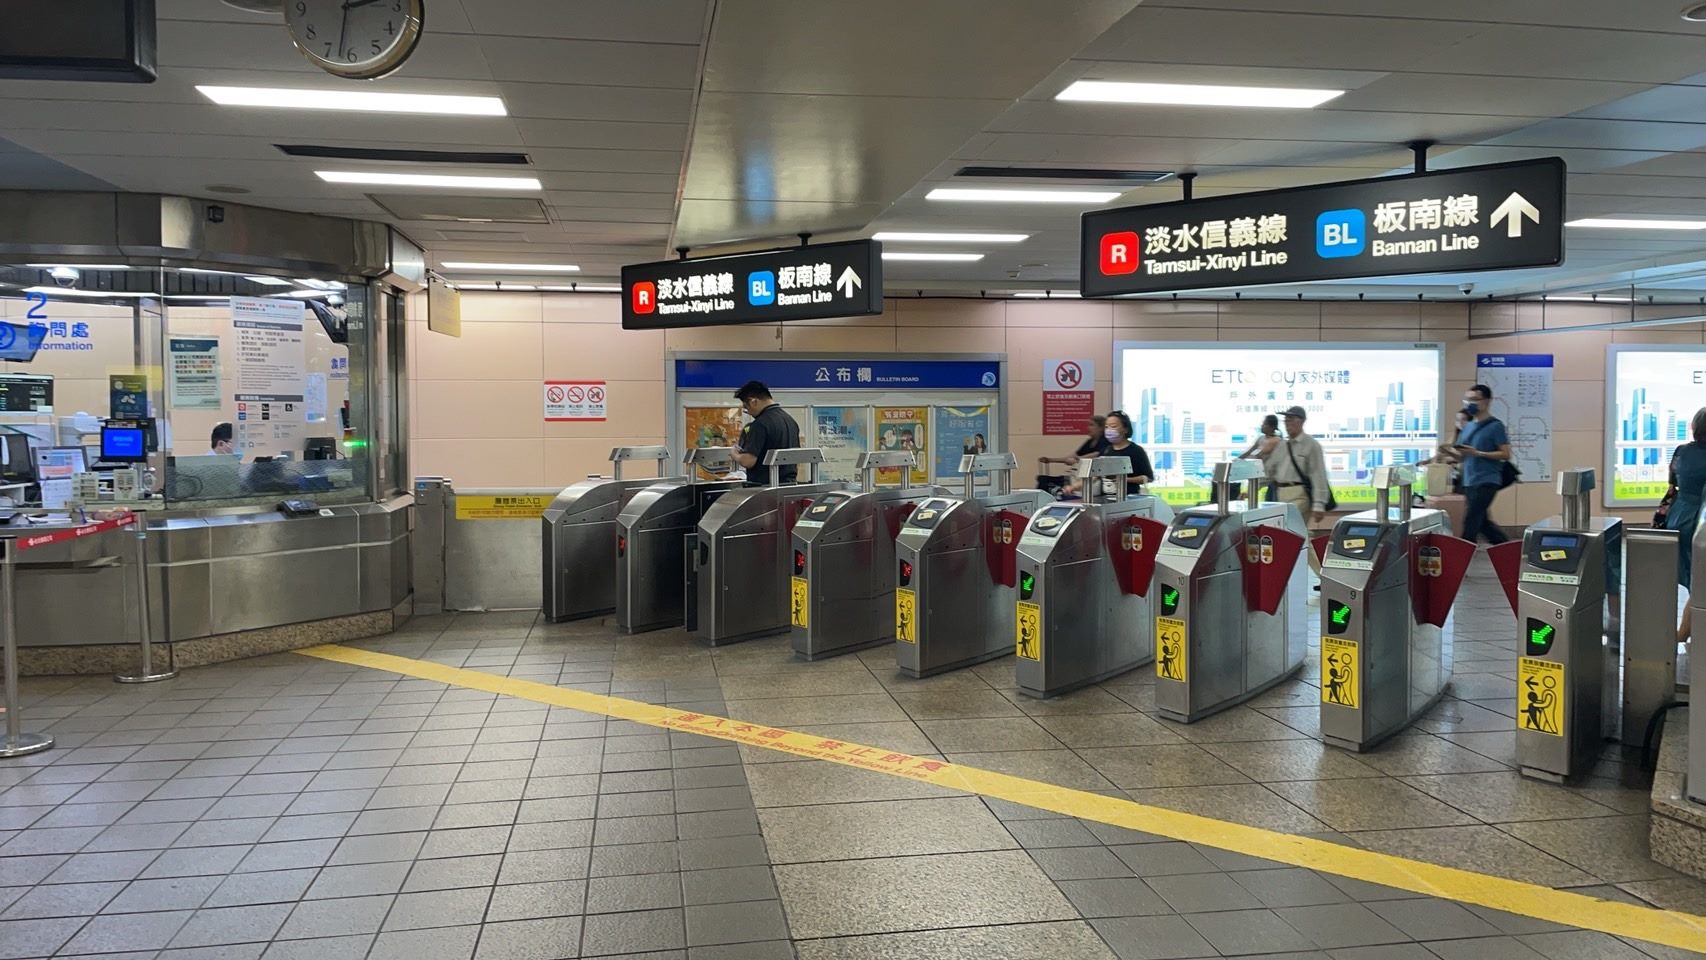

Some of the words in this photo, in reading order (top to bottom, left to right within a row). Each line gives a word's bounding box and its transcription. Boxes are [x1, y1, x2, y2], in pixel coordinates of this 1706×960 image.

[296, 2, 306, 16] 9
[306, 24, 316, 40] 8
[384, 20, 395, 35] 4
[324, 42, 332, 58] 7
[347, 47, 357, 63] 6
[371, 40, 381, 55] 5
[1373, 195, 1479, 234] 板南線
[1145, 214, 1288, 255] 淡水信義線
[1323, 223, 1357, 246] BL
[1111, 244, 1127, 263] R
[1372, 238, 1437, 257] Bannan
[1441, 234, 1480, 252] Line
[1145, 251, 1247, 275] Tamsui-Xinyi
[1250, 249, 1288, 267] Line
[778, 263, 832, 290] 板南線
[657, 272, 734, 300] 淡水信義線
[752, 280, 771, 297] BL
[26, 292, 48, 319] 2
[639, 291, 649, 306] R
[778, 291, 810, 306] Bannan
[812, 289, 832, 304] Line
[658, 300, 712, 315] Tamsui-Xinyi
[714, 298, 734, 311] Line
[815, 368, 872, 382] 公布欄
[1211, 370, 1296, 388] ETtoay
[1350, 591, 1357, 600] 9
[1555, 608, 1564, 620] 8
